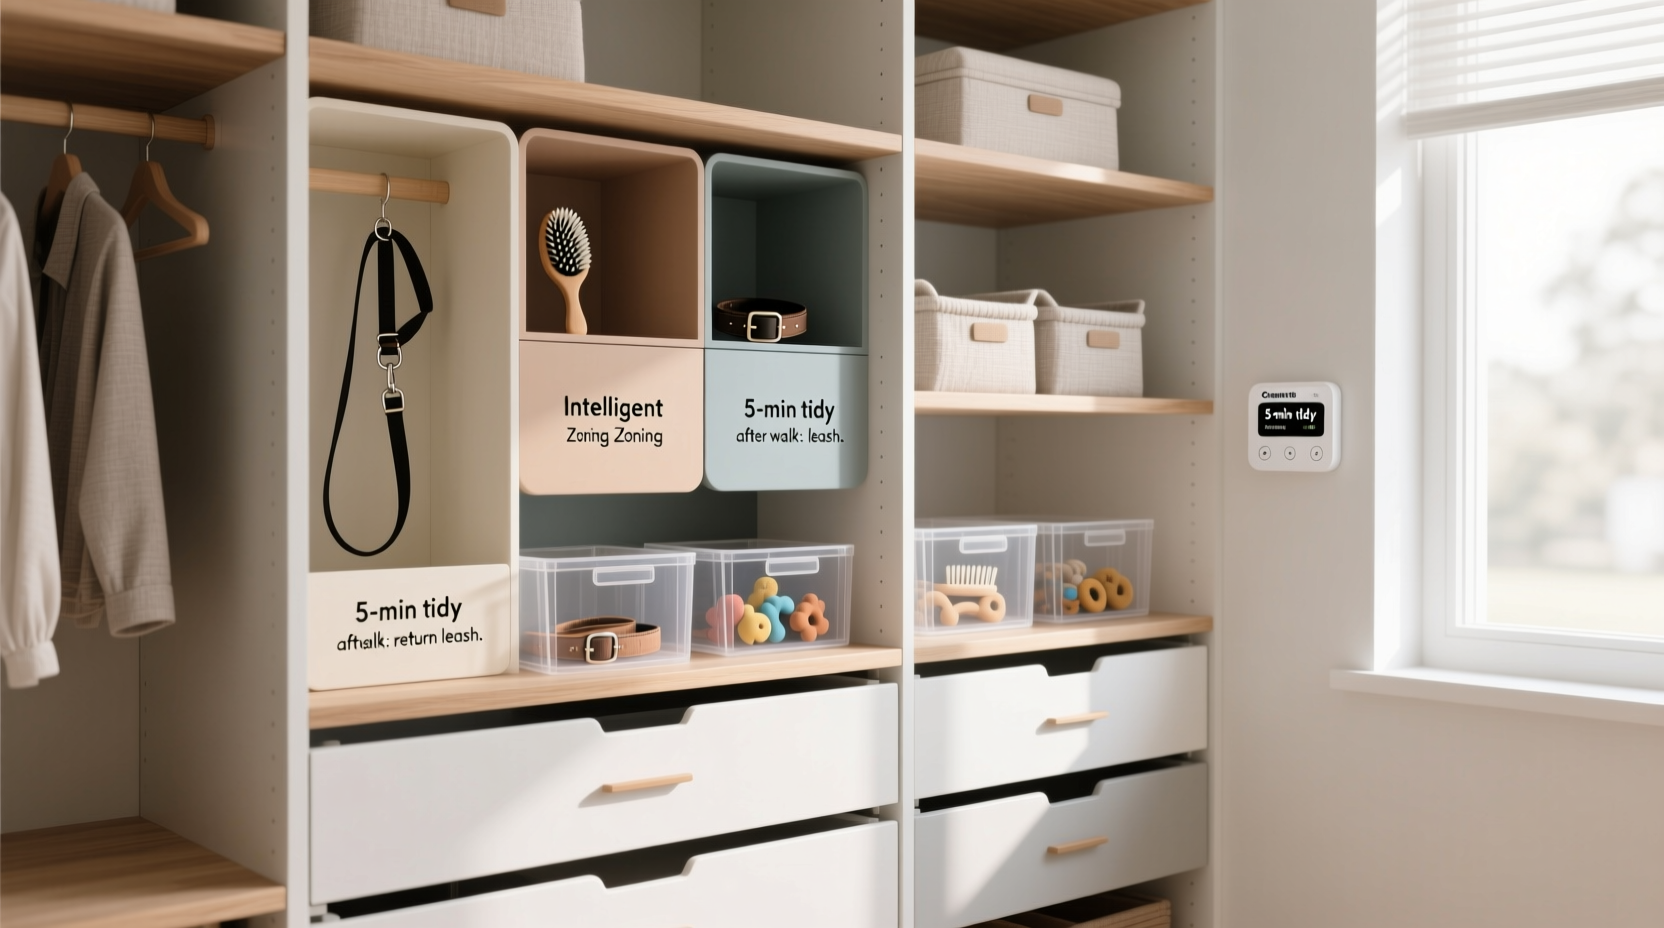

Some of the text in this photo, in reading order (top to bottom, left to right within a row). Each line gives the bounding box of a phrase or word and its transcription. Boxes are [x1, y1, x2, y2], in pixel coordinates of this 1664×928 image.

[564, 395, 664, 423] Intelligent
[744, 398, 835, 425] 5-min tidy
[613, 426, 663, 448] Zoning
[736, 426, 845, 443] after walk: leash.
[355, 595, 463, 623] 5-min tidy
[394, 630, 438, 648] return
[441, 626, 483, 644] leash.
